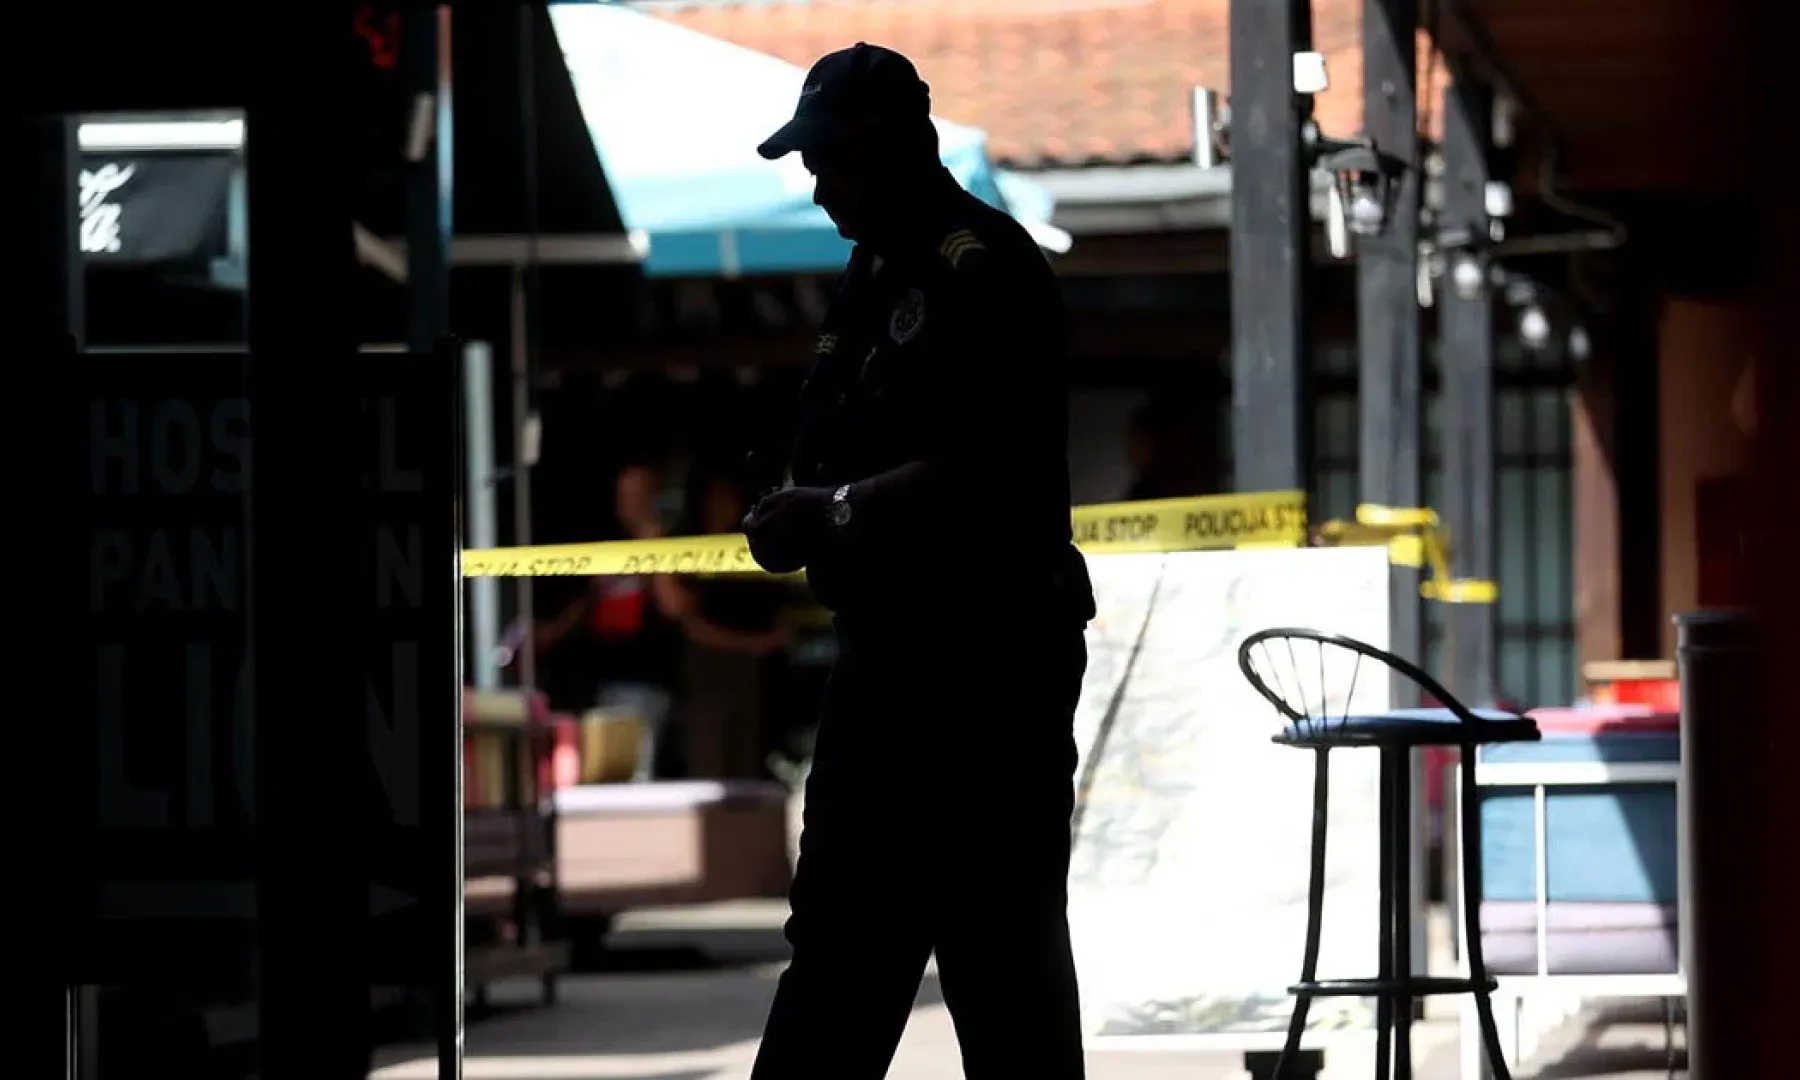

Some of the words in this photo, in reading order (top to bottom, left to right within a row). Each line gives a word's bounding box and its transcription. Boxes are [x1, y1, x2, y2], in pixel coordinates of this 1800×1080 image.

[89, 397, 424, 495] HOSL
[89, 524, 424, 612] PANN
[1104, 513, 1155, 541] STOP
